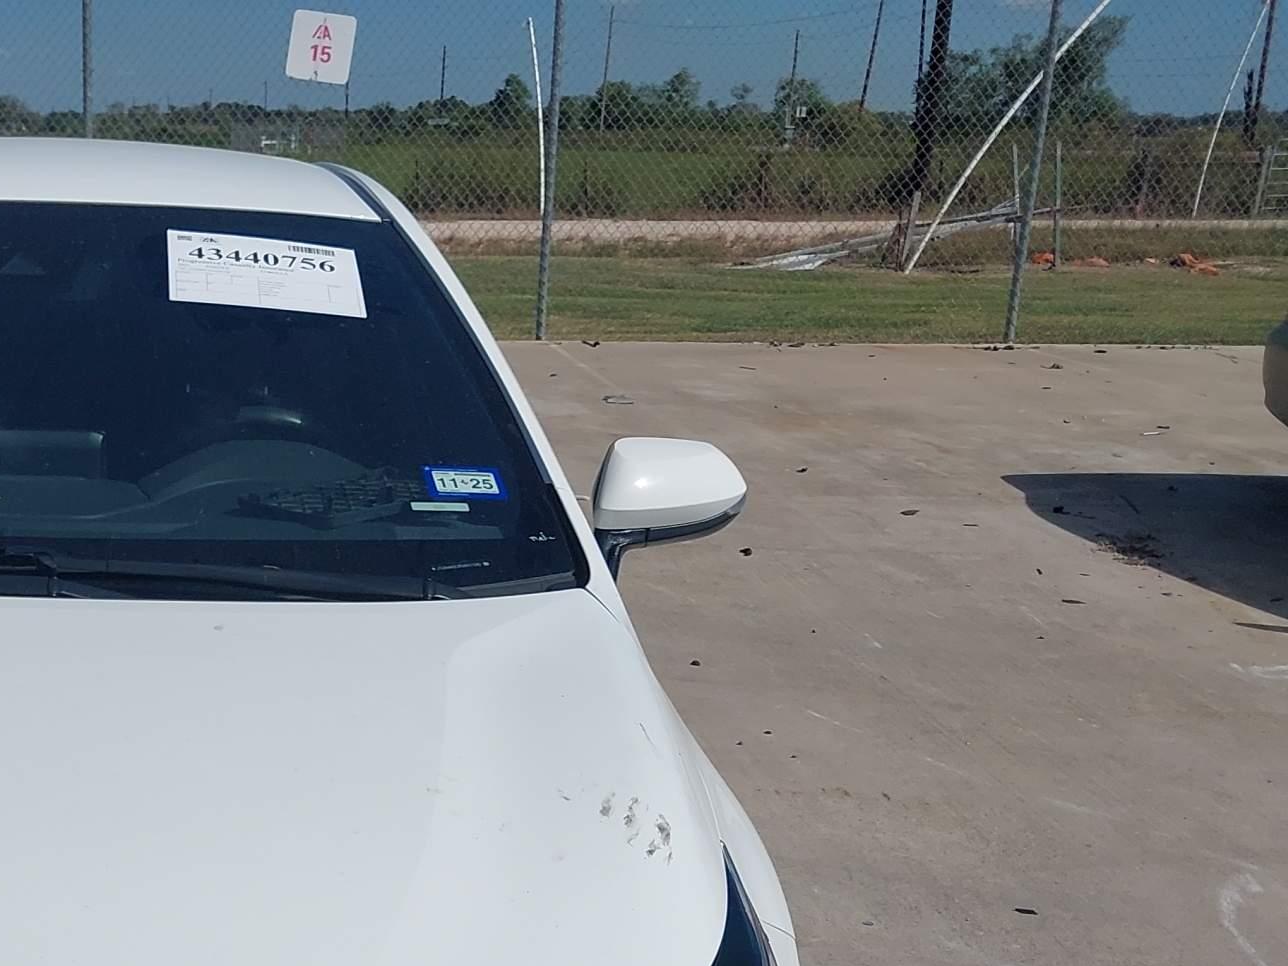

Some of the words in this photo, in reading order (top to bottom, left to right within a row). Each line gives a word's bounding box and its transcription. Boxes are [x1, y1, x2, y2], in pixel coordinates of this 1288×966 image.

[310, 45, 332, 63] 15
[188, 247, 336, 273] 43440756
[469, 478, 494, 490] 25
